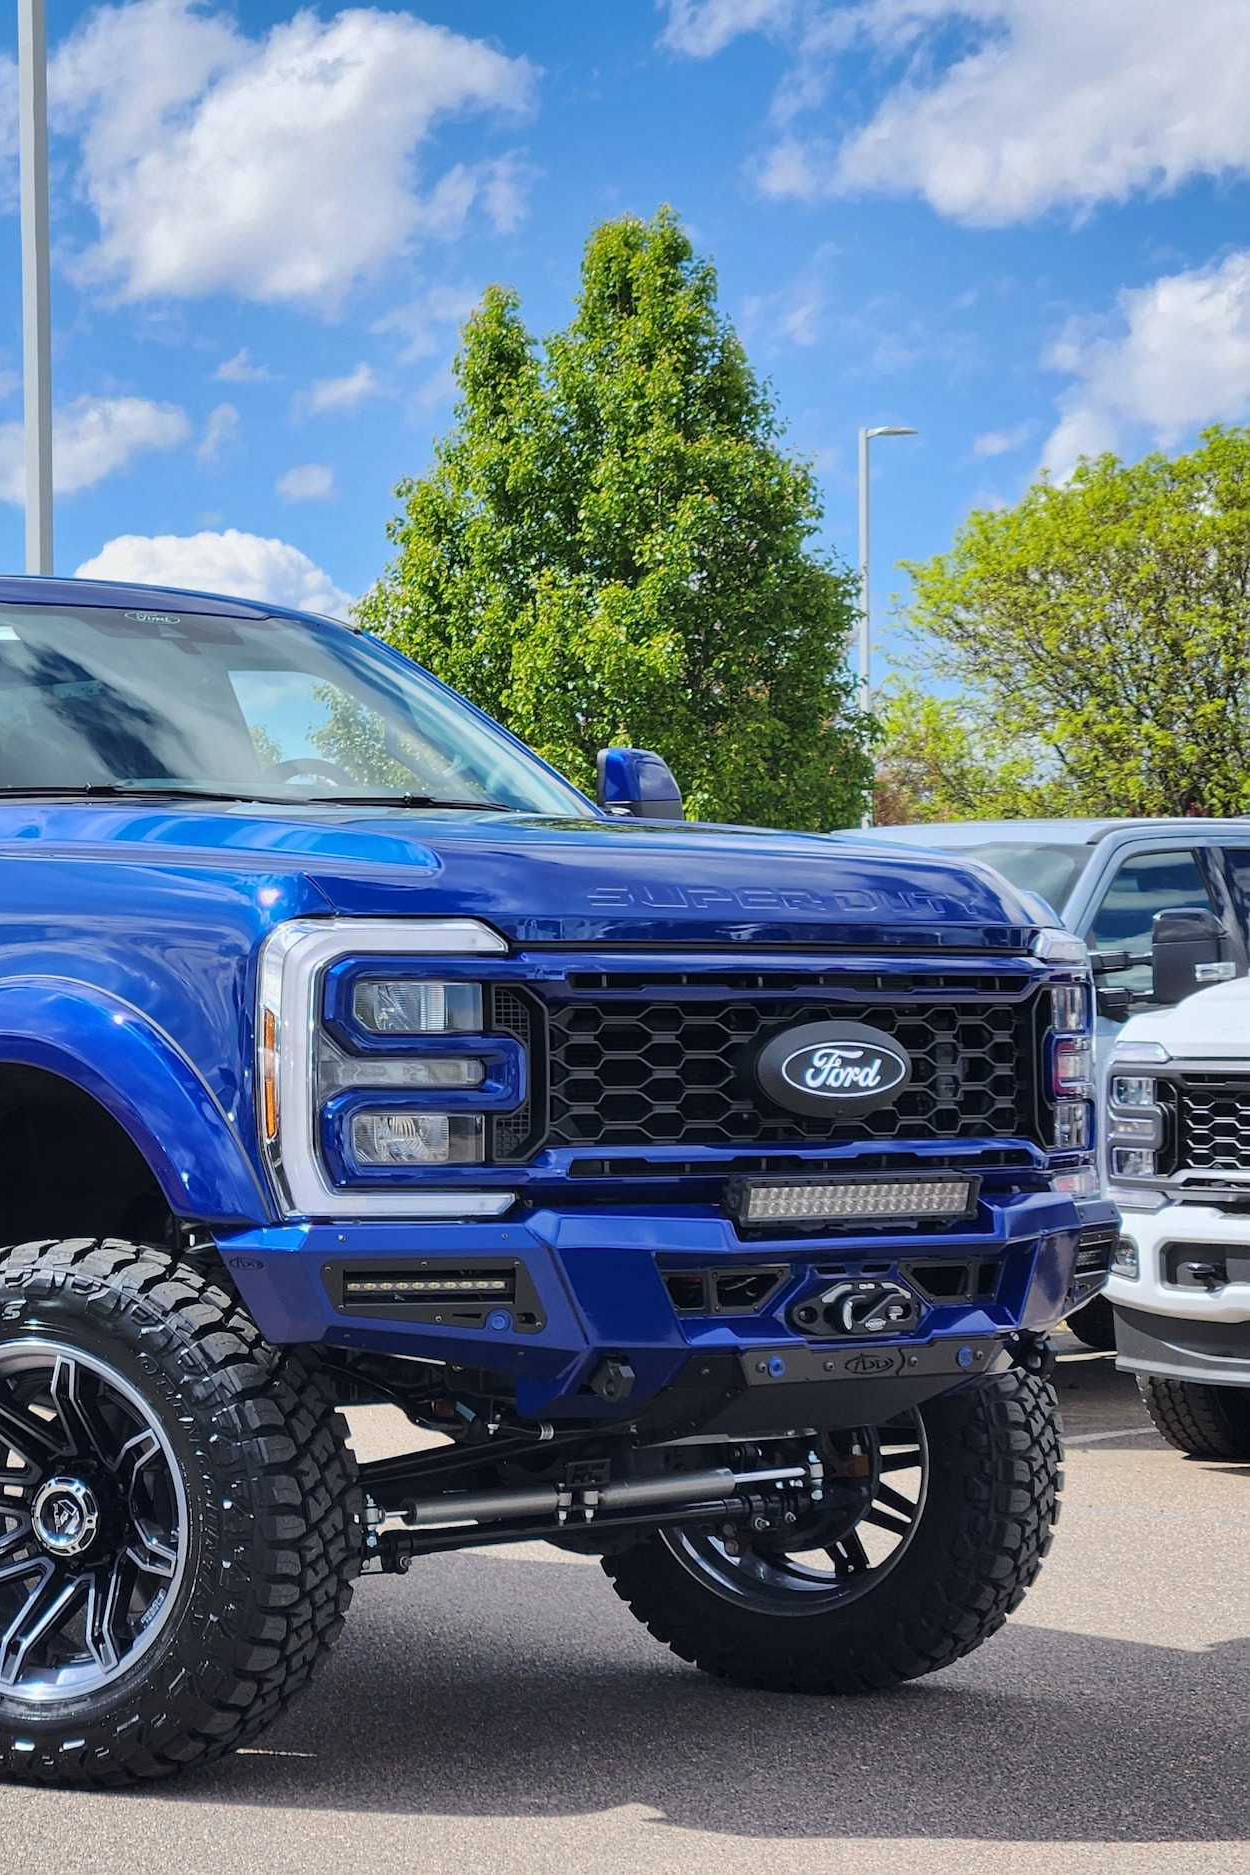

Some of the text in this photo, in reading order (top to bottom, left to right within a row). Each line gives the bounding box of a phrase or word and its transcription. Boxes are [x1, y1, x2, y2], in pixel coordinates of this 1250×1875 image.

[586, 886, 979, 915] SUPER DUTY
[805, 1048, 883, 1088] Ford
